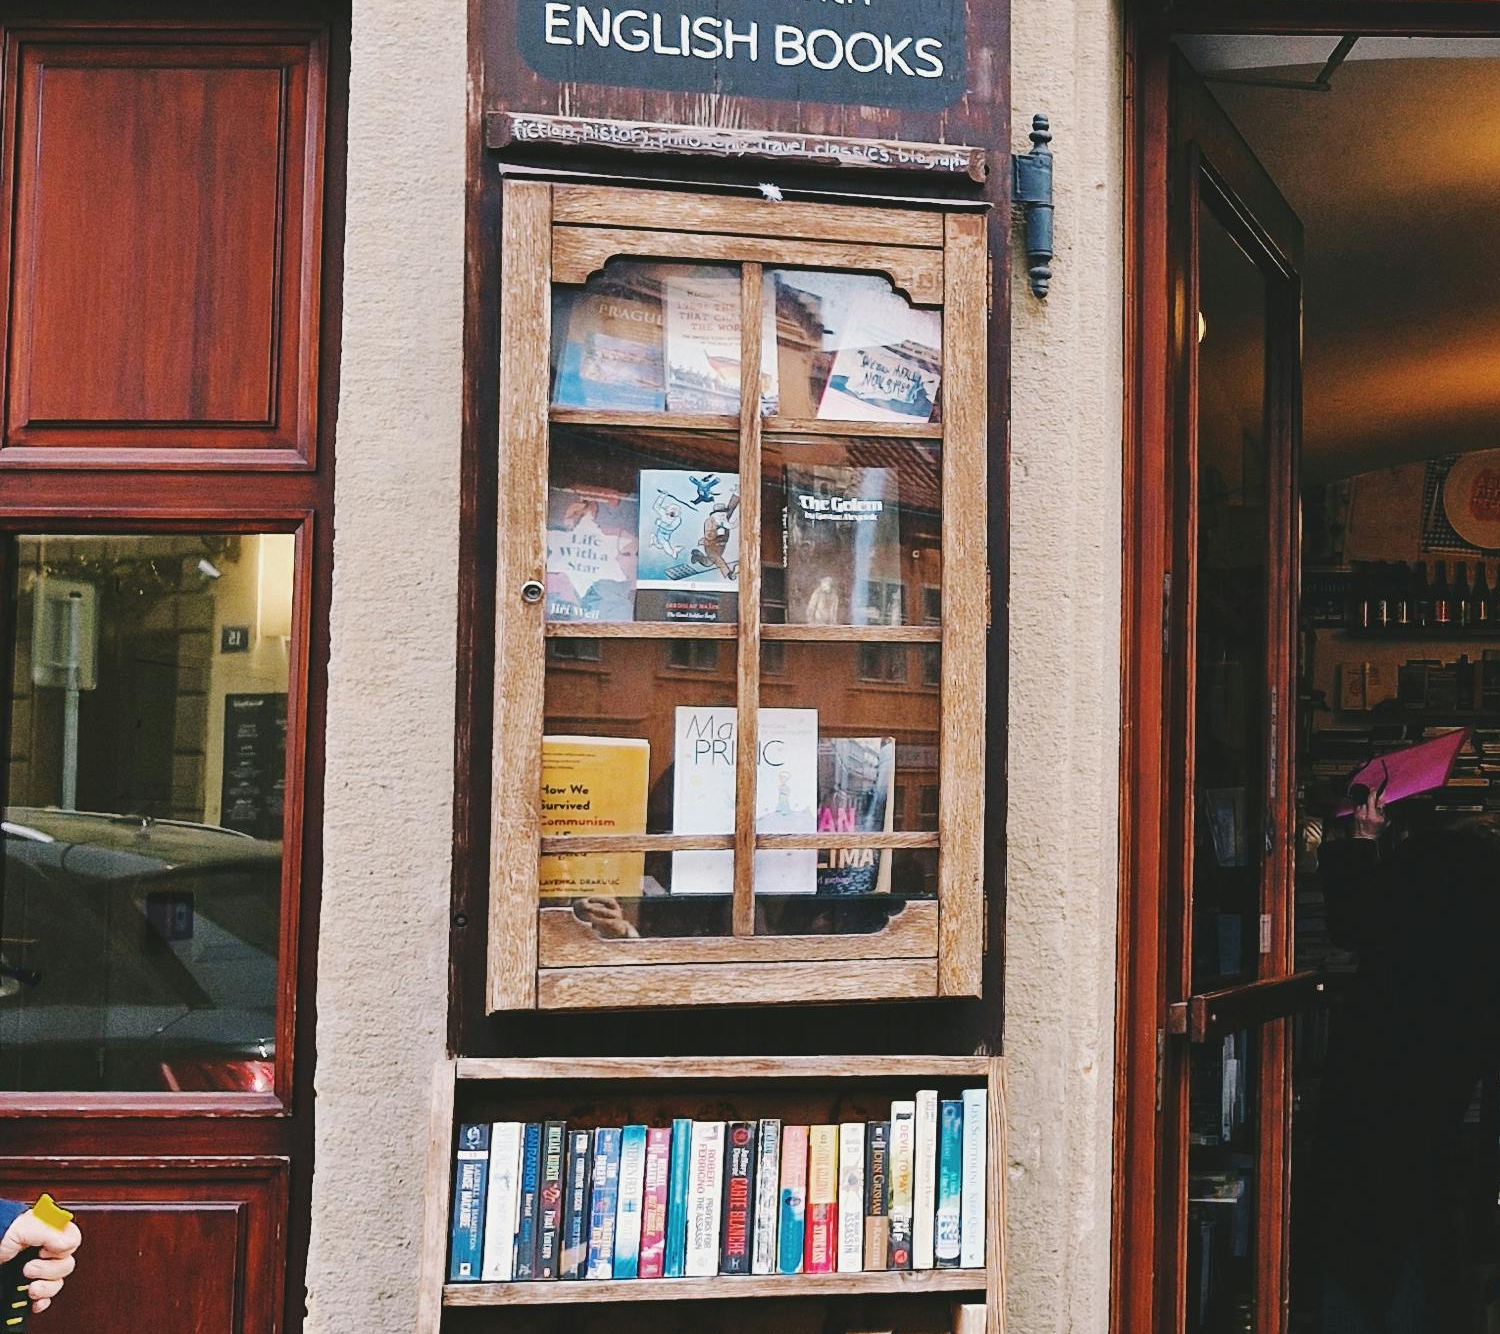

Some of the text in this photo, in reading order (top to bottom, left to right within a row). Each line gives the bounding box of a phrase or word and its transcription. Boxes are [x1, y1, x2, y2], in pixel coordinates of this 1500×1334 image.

[544, 2, 944, 78] ENGLISH BOOKS
[799, 495, 830, 512] The
[570, 784, 589, 795] We
[526, 1147, 537, 1191] RANKIN
[697, 1144, 706, 1193] FERRIGNO
[707, 1149, 716, 1187] ROBERT
[872, 1150, 883, 1173] JOHN
[899, 1125, 908, 1194] DEVIL TO PAY
[728, 1178, 748, 1255] CARTE BLANCHE
